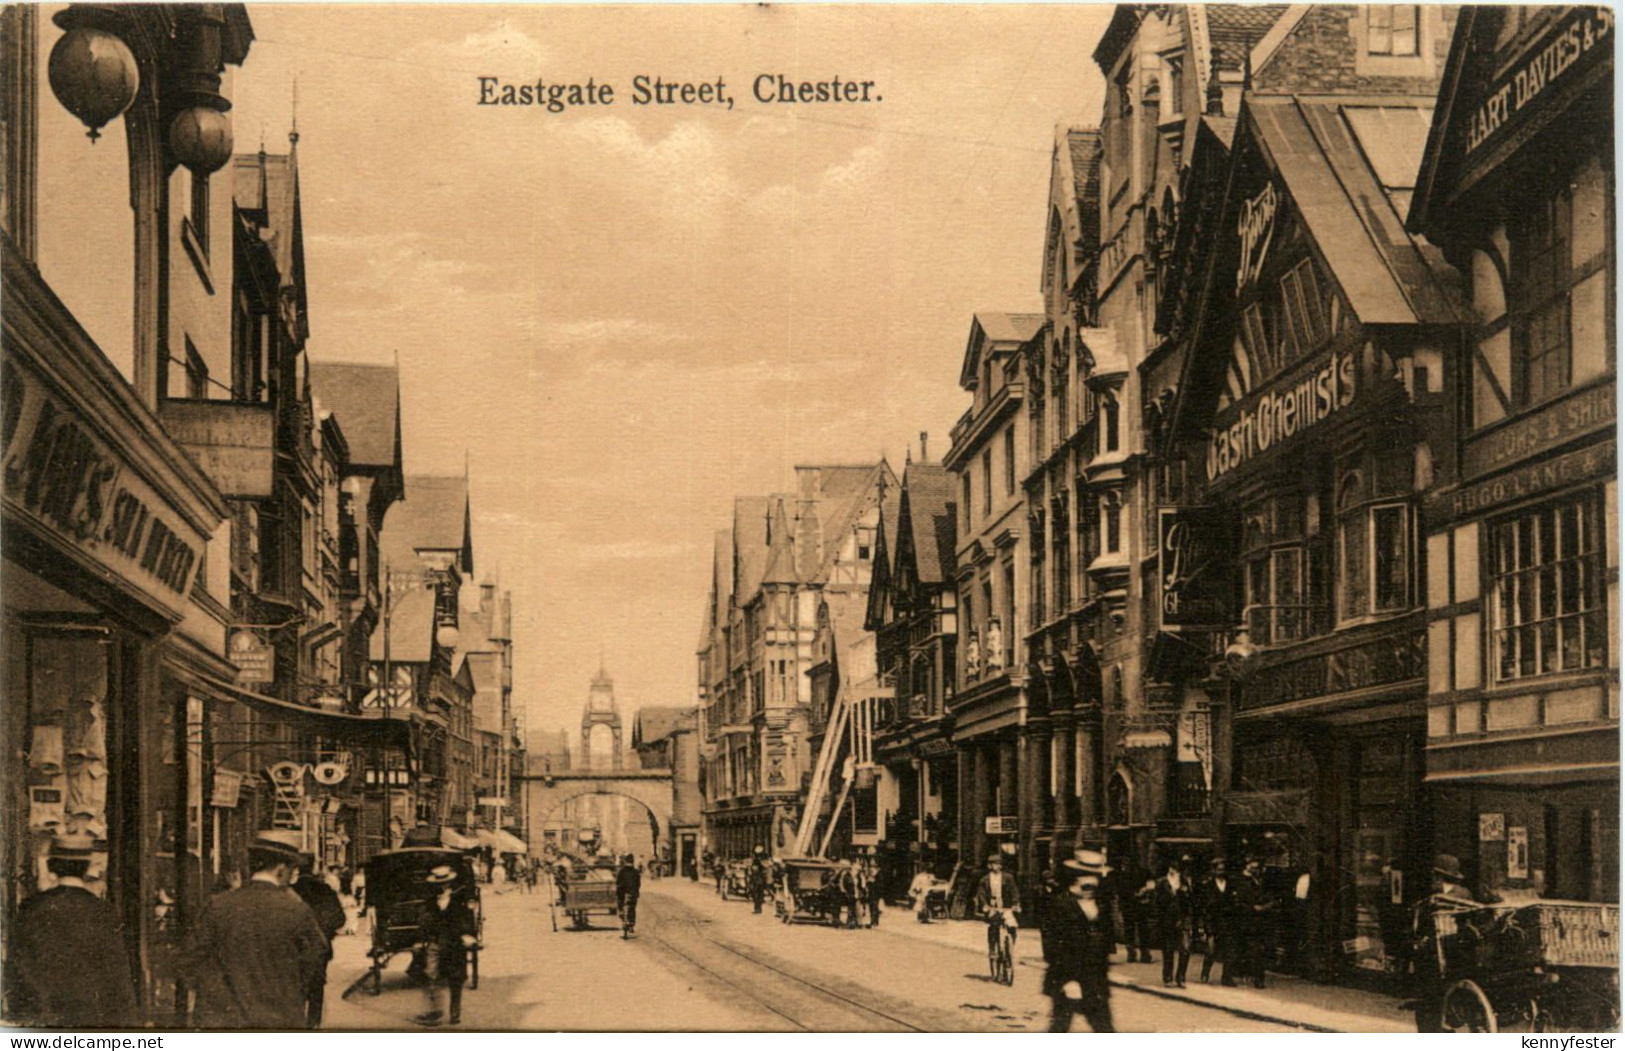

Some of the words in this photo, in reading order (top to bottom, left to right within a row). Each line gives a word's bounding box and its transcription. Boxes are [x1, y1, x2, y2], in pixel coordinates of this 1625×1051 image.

[1514, 20, 1580, 111] DAVIES
[1583, 18, 1594, 51] &
[1257, 351, 1356, 451] Chemists
[1452, 483, 1505, 516] HUGO
